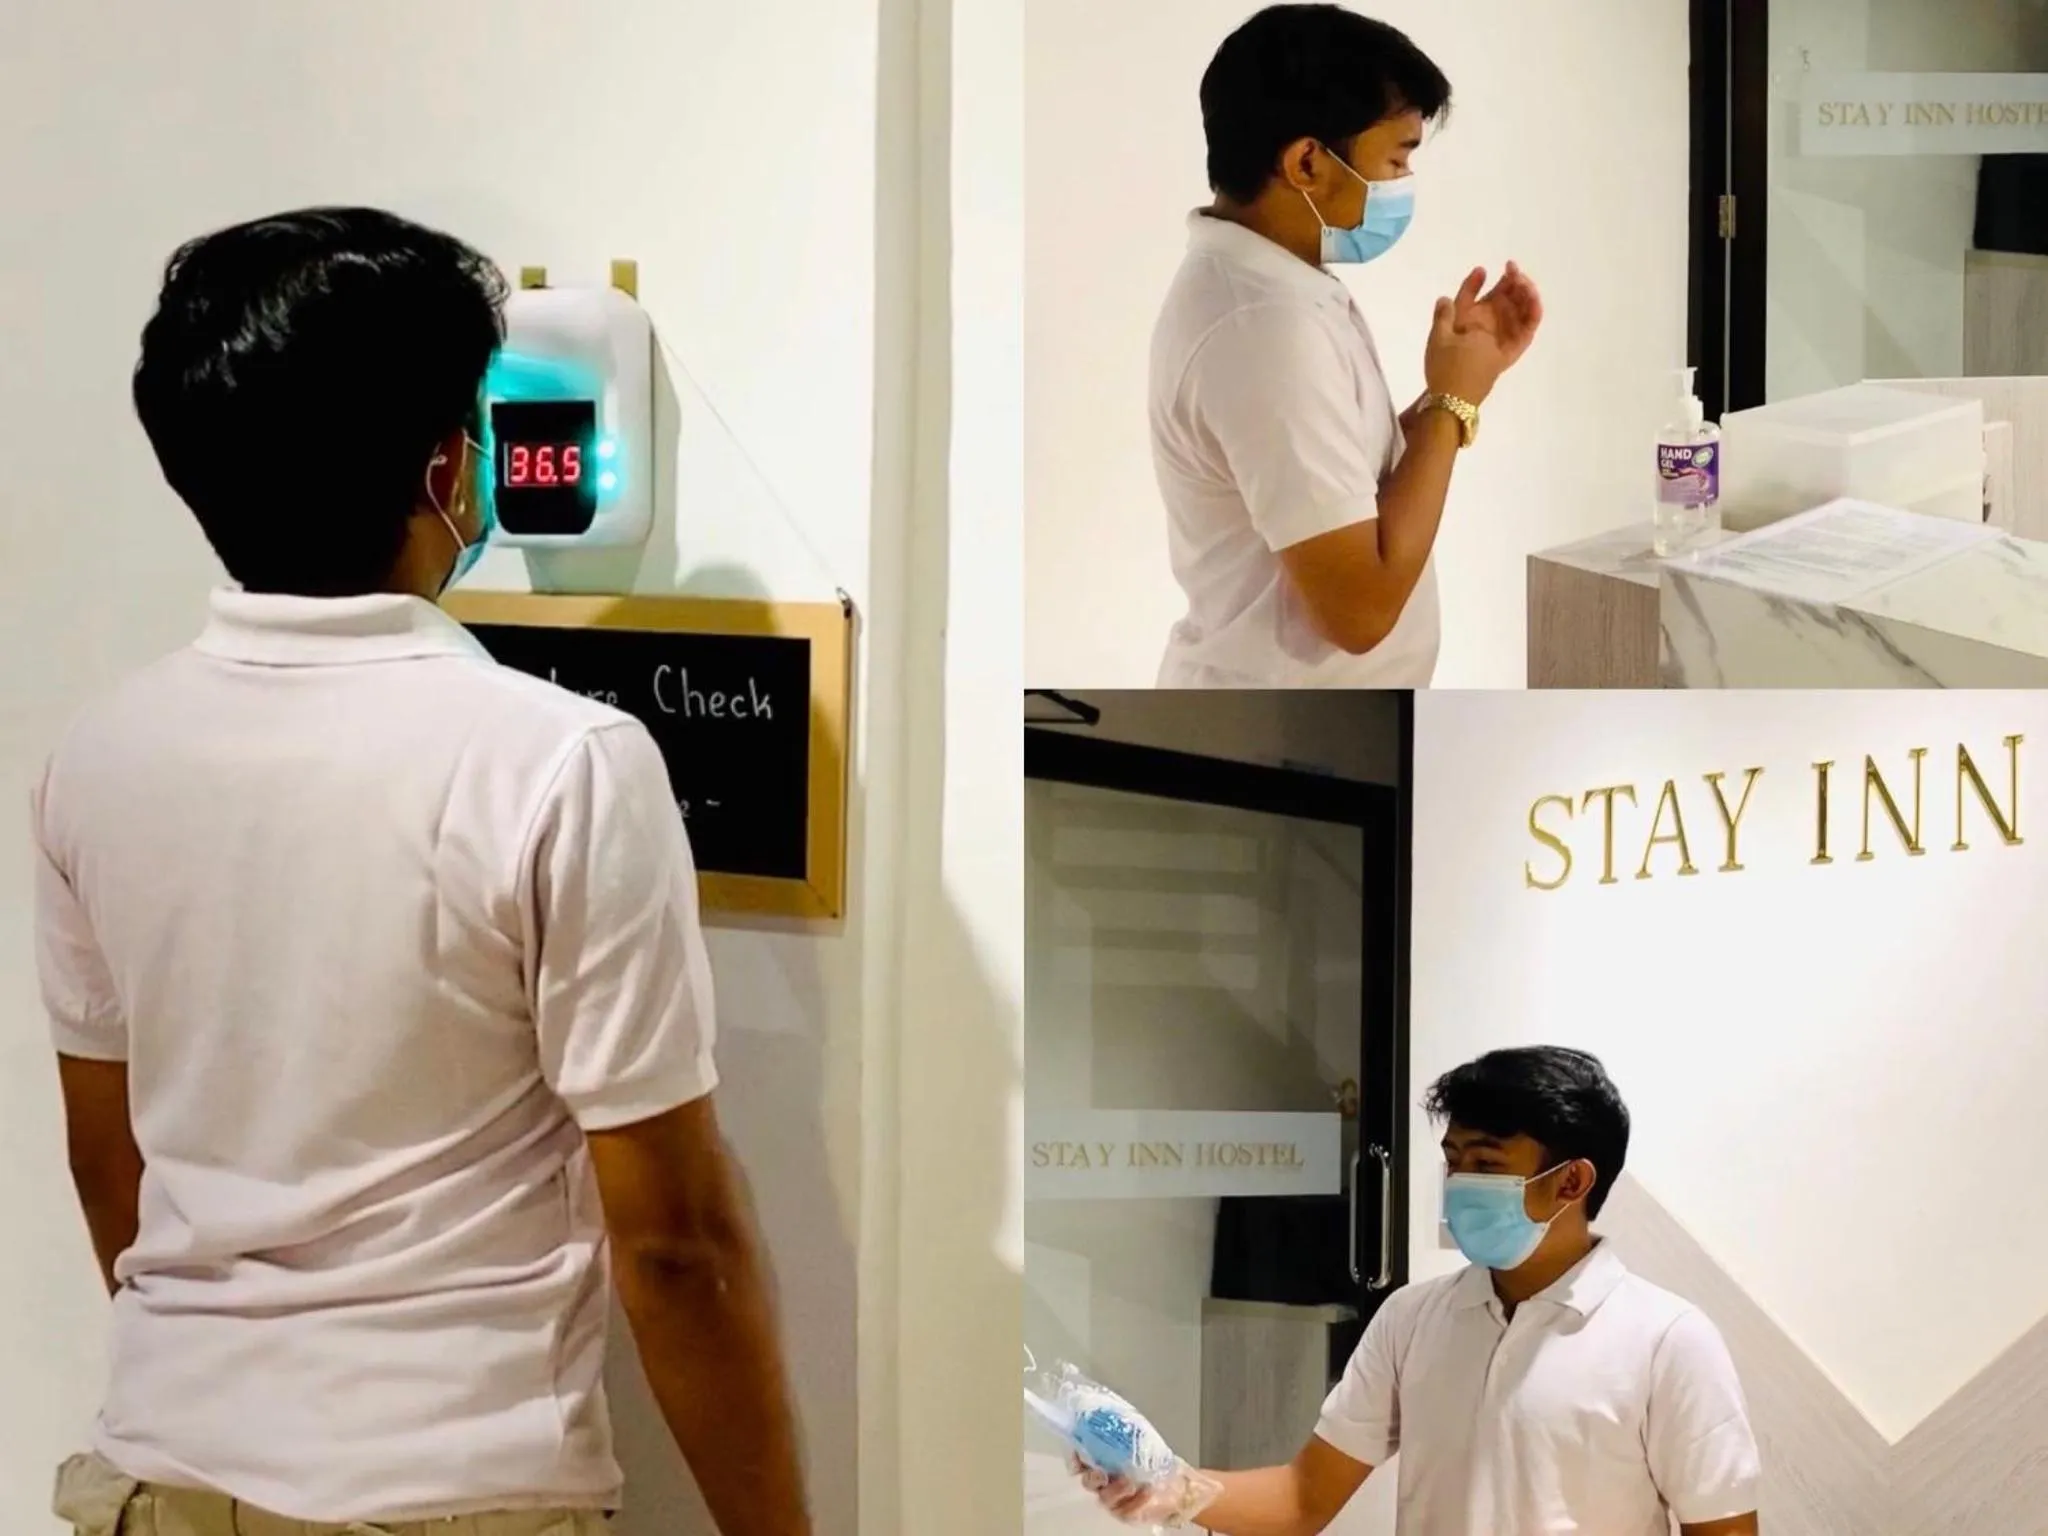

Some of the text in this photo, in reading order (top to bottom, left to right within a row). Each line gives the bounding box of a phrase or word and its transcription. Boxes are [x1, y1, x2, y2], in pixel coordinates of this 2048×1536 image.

[1818, 102, 1892, 126] STAY
[1903, 103, 1955, 125] INN
[510, 445, 582, 484] 36.5
[1661, 447, 1692, 460] HAND
[653, 664, 774, 721] Check
[1525, 734, 2025, 890] STAY INN
[1032, 1142, 1305, 1168] STAY INN HOSTEL
